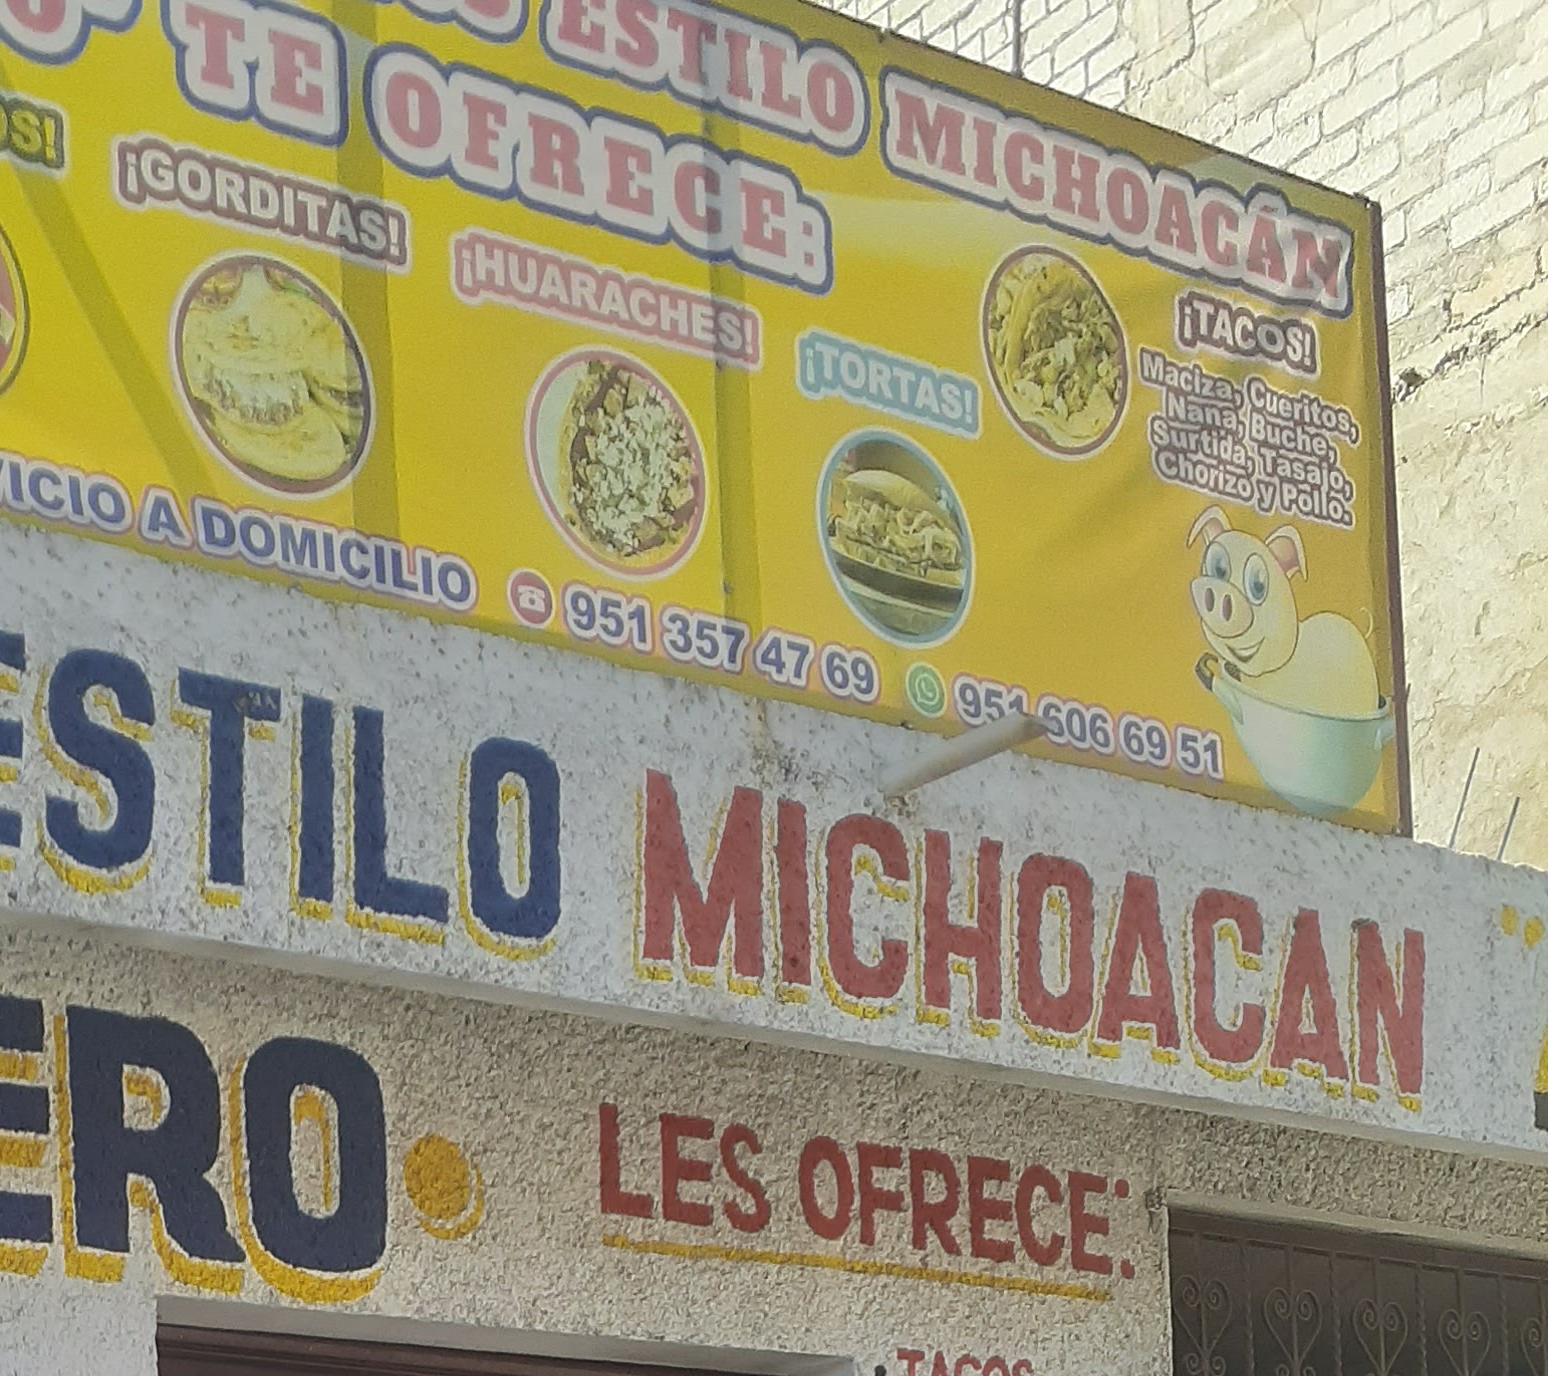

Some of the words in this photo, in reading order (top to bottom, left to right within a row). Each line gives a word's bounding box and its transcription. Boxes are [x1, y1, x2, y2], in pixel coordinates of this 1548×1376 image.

[185, 8, 324, 115] TE
[386, 70, 815, 269] OFRECE:
[558, 0, 854, 133] ESTILO
[894, 90, 1346, 299] MICHOACÁN
[127, 150, 399, 255] ¡GORDITAS!
[461, 244, 753, 356] ¡HUARACHES!
[1183, 301, 1311, 366] ¡TACOS!
[804, 345, 974, 424] ¡TORTAS!
[1142, 353, 1241, 404] Maciza,
[1250, 383, 1357, 437] Cueritos,
[1168, 392, 1243, 437] Nana,
[1251, 412, 1333, 460] Buche,
[1153, 422, 1253, 471] Surtida,
[1262, 448, 1351, 494] Tasajo,
[1159, 455, 1251, 498] Chorizo
[1258, 483, 1274, 508] y
[1283, 484, 1350, 521] Pollo.
[147, 503, 186, 538] A
[201, 506, 470, 604] DOMICILIO
[570, 591, 647, 644] 951
[663, 613, 746, 664] 357
[761, 637, 810, 679] 47
[825, 652, 875, 695] 69
[1042, 702, 1111, 748] 606
[1123, 721, 1166, 761] 69
[1181, 732, 1219, 774] 51
[637, 769, 1426, 1100] MICHOACAN
[598, 1103, 770, 1232] LES
[799, 1138, 1135, 1278] OFRECE:
